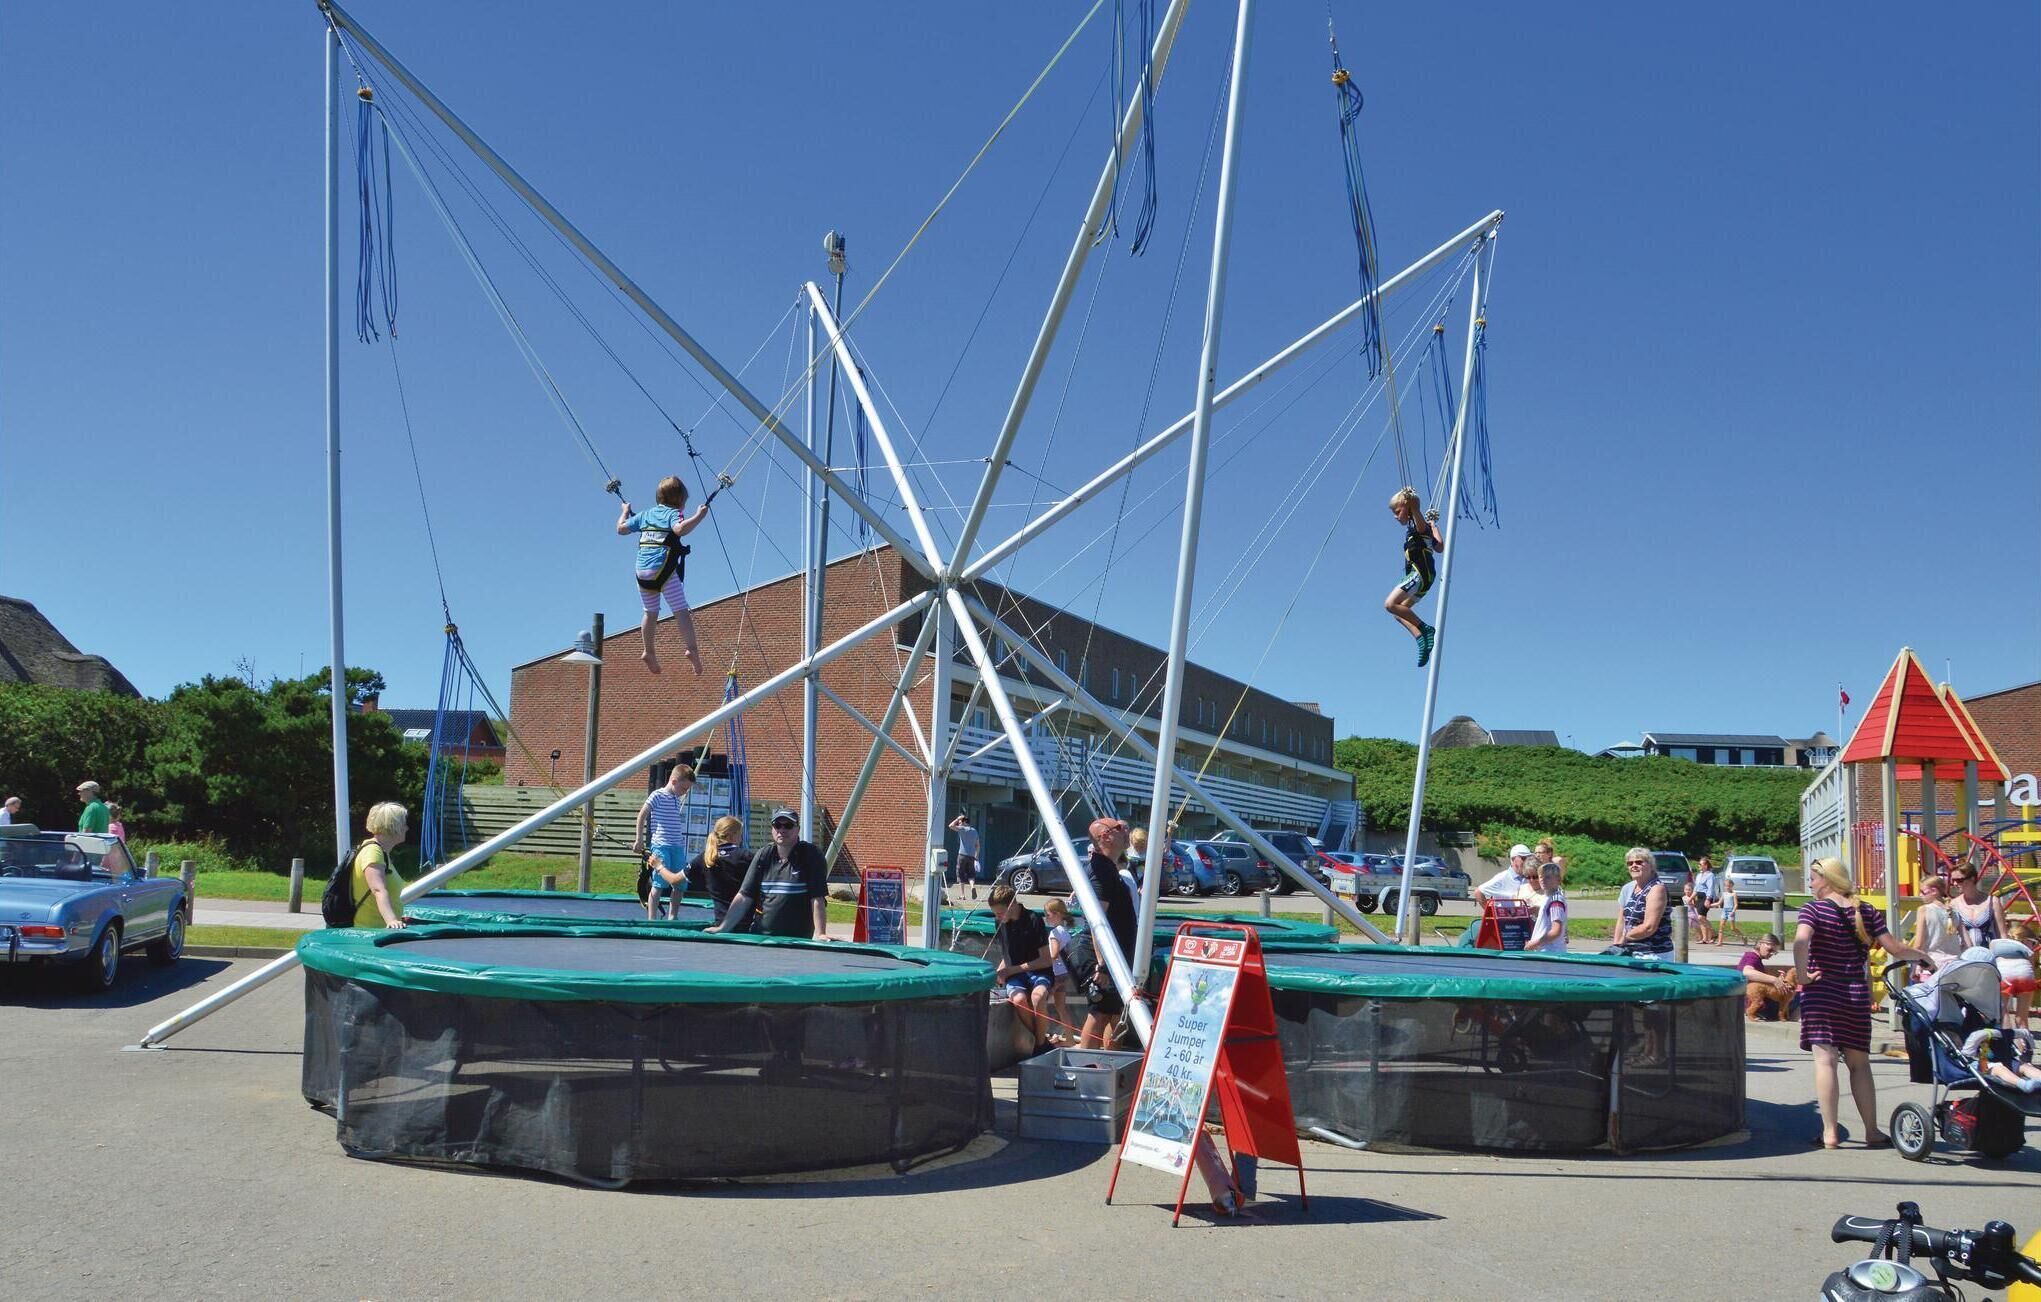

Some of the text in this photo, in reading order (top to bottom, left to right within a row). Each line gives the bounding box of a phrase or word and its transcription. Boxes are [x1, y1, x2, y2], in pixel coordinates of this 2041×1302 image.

[1178, 1015, 1208, 1032] Super
[1168, 1031, 1206, 1049] Jumper
[1164, 1046, 1171, 1059] 2
[1179, 1049, 1192, 1063] 60
[1167, 1064, 1192, 1080] 40 kr.
